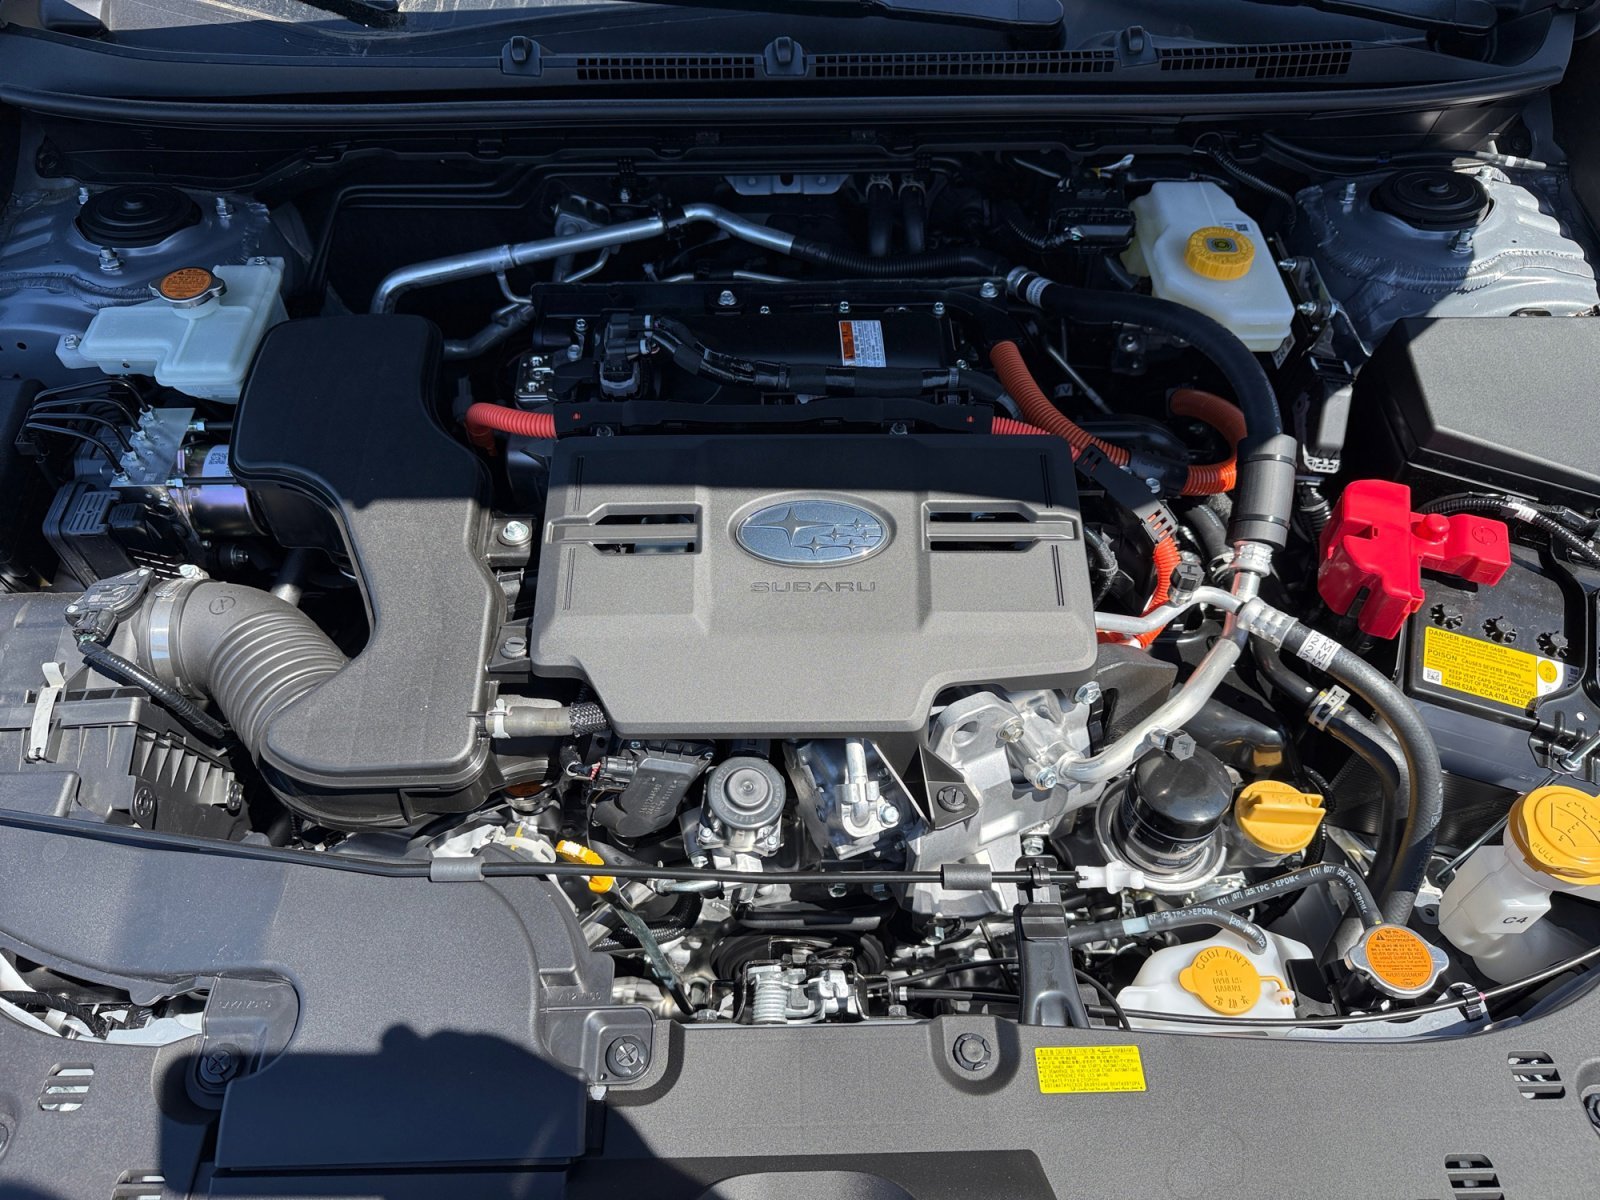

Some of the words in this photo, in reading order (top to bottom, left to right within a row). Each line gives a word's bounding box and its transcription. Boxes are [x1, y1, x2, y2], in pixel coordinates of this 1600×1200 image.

[750, 581, 876, 593] SUBARU
[1428, 628, 1458, 642] DANGER
[1310, 636, 1320, 646] 2
[1320, 642, 1332, 652] M
[1305, 645, 1314, 654] 2
[1314, 650, 1327, 661] M
[1427, 648, 1457, 662] POISON
[1461, 657, 1481, 668] CAUSES
[1479, 687, 1493, 697] CCA
[1532, 841, 1554, 864] PULL
[1256, 884, 1270, 893] TPC
[1172, 909, 1187, 918] TPC
[1502, 916, 1529, 924] C4
